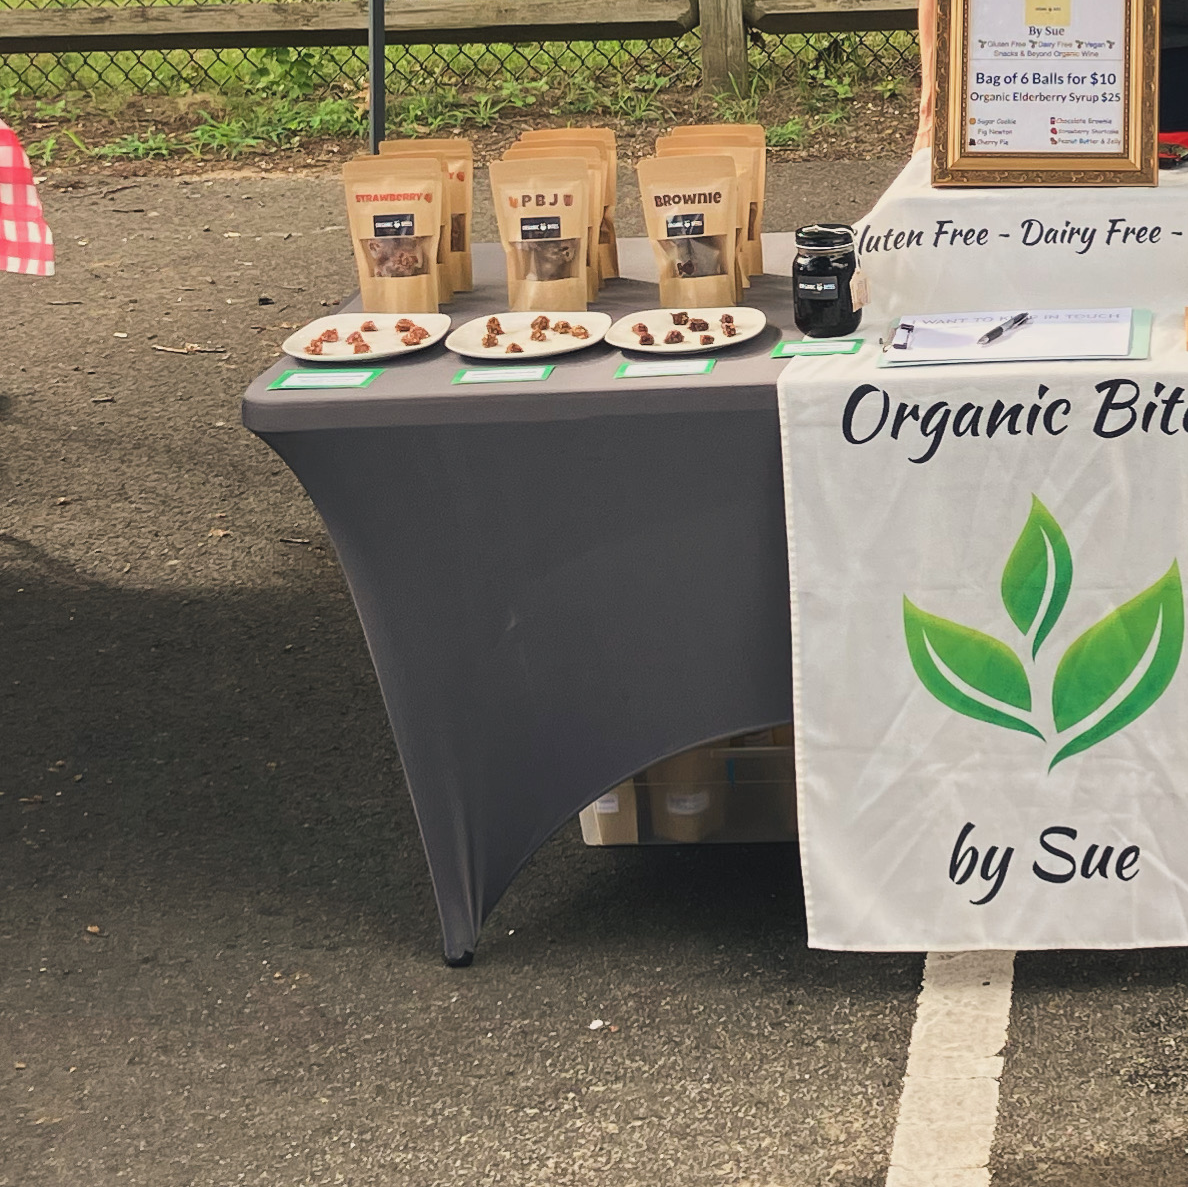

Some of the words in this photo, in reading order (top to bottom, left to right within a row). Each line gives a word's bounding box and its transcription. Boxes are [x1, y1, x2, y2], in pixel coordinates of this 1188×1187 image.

[1028, 26, 1043, 38] By
[1045, 26, 1065, 36] Sue
[976, 72, 1001, 87] Bag
[1004, 72, 1018, 84] of
[1020, 72, 1029, 85] 6
[1032, 72, 1064, 85] Balls
[1067, 72, 1087, 85] for
[1090, 72, 1117, 86] $10
[970, 91, 1010, 103] Organic
[1013, 91, 1067, 103] Elderberry
[1069, 92, 1099, 103] Syrup
[1101, 92, 1121, 103] $25
[854, 224, 923, 255] luten
[932, 220, 988, 250] Free
[1021, 218, 1097, 255] Dairy
[1105, 218, 1162, 248] Free
[922, 317, 965, 325] WANT
[999, 314, 1038, 323] KP
[841, 383, 1072, 465] Organic
[949, 822, 1014, 905] by
[1032, 826, 1141, 884] Sue
